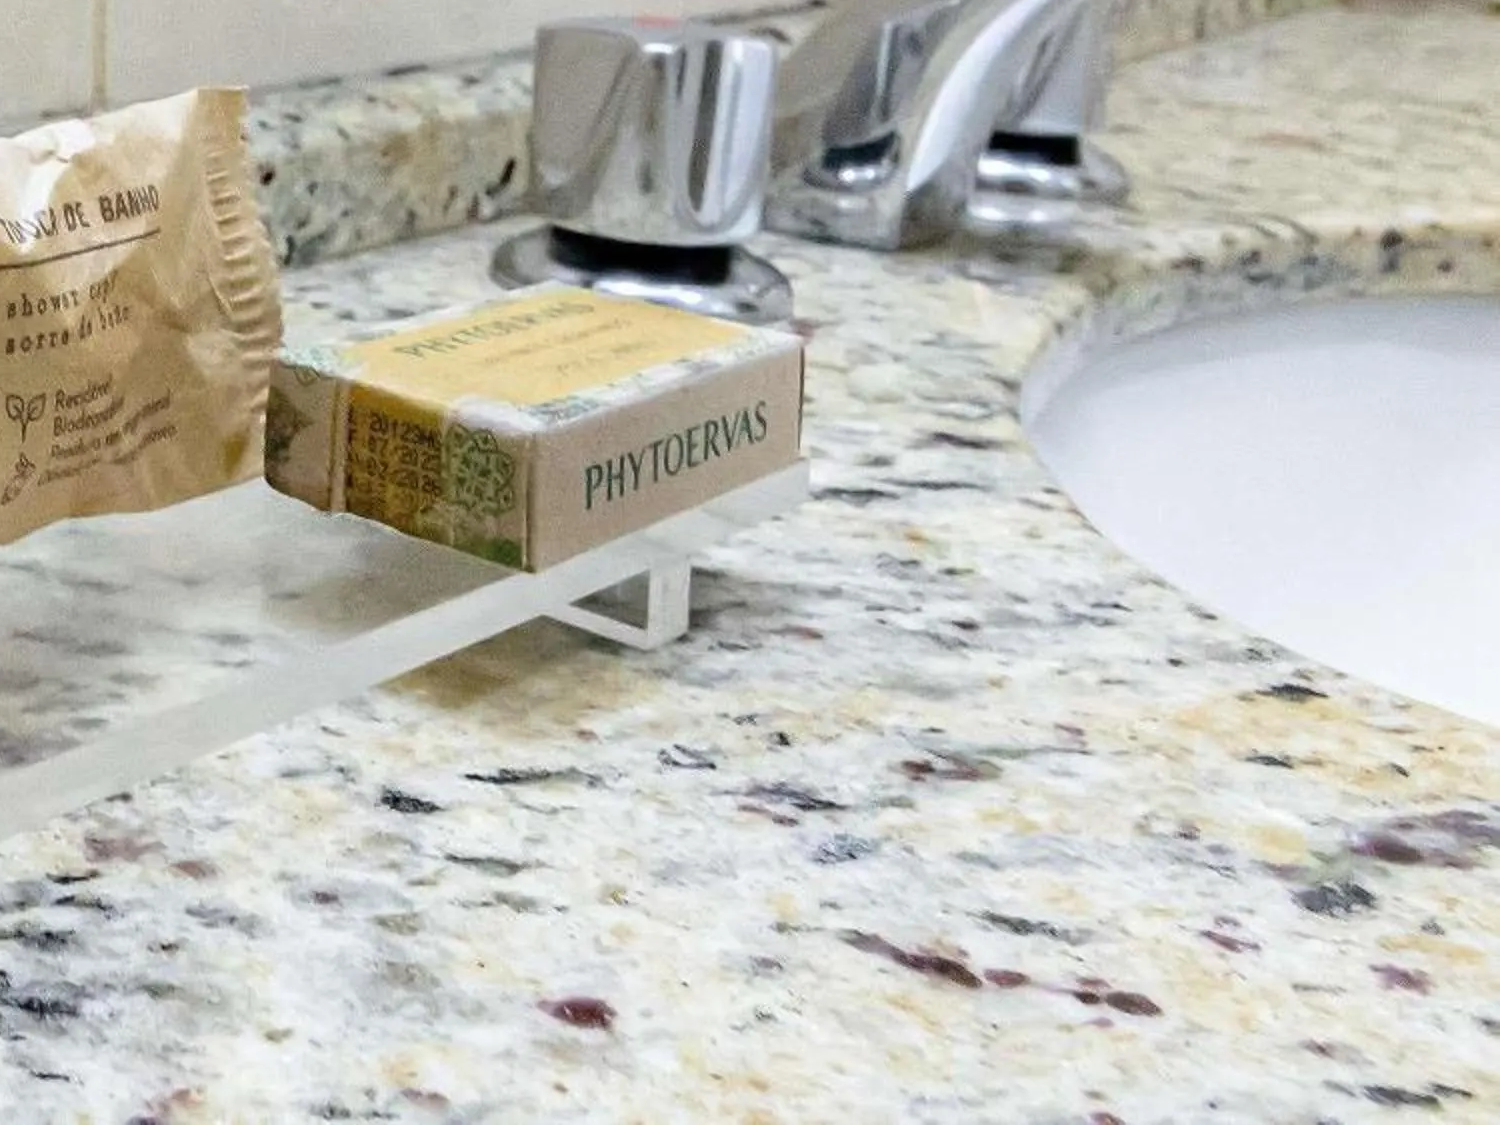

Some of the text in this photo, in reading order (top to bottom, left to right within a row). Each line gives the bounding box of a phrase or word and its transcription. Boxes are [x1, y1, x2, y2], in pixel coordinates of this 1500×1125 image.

[62, 201, 91, 232] DE
[97, 183, 160, 224] BANHO
[583, 399, 769, 511] PHYTOERVAS
